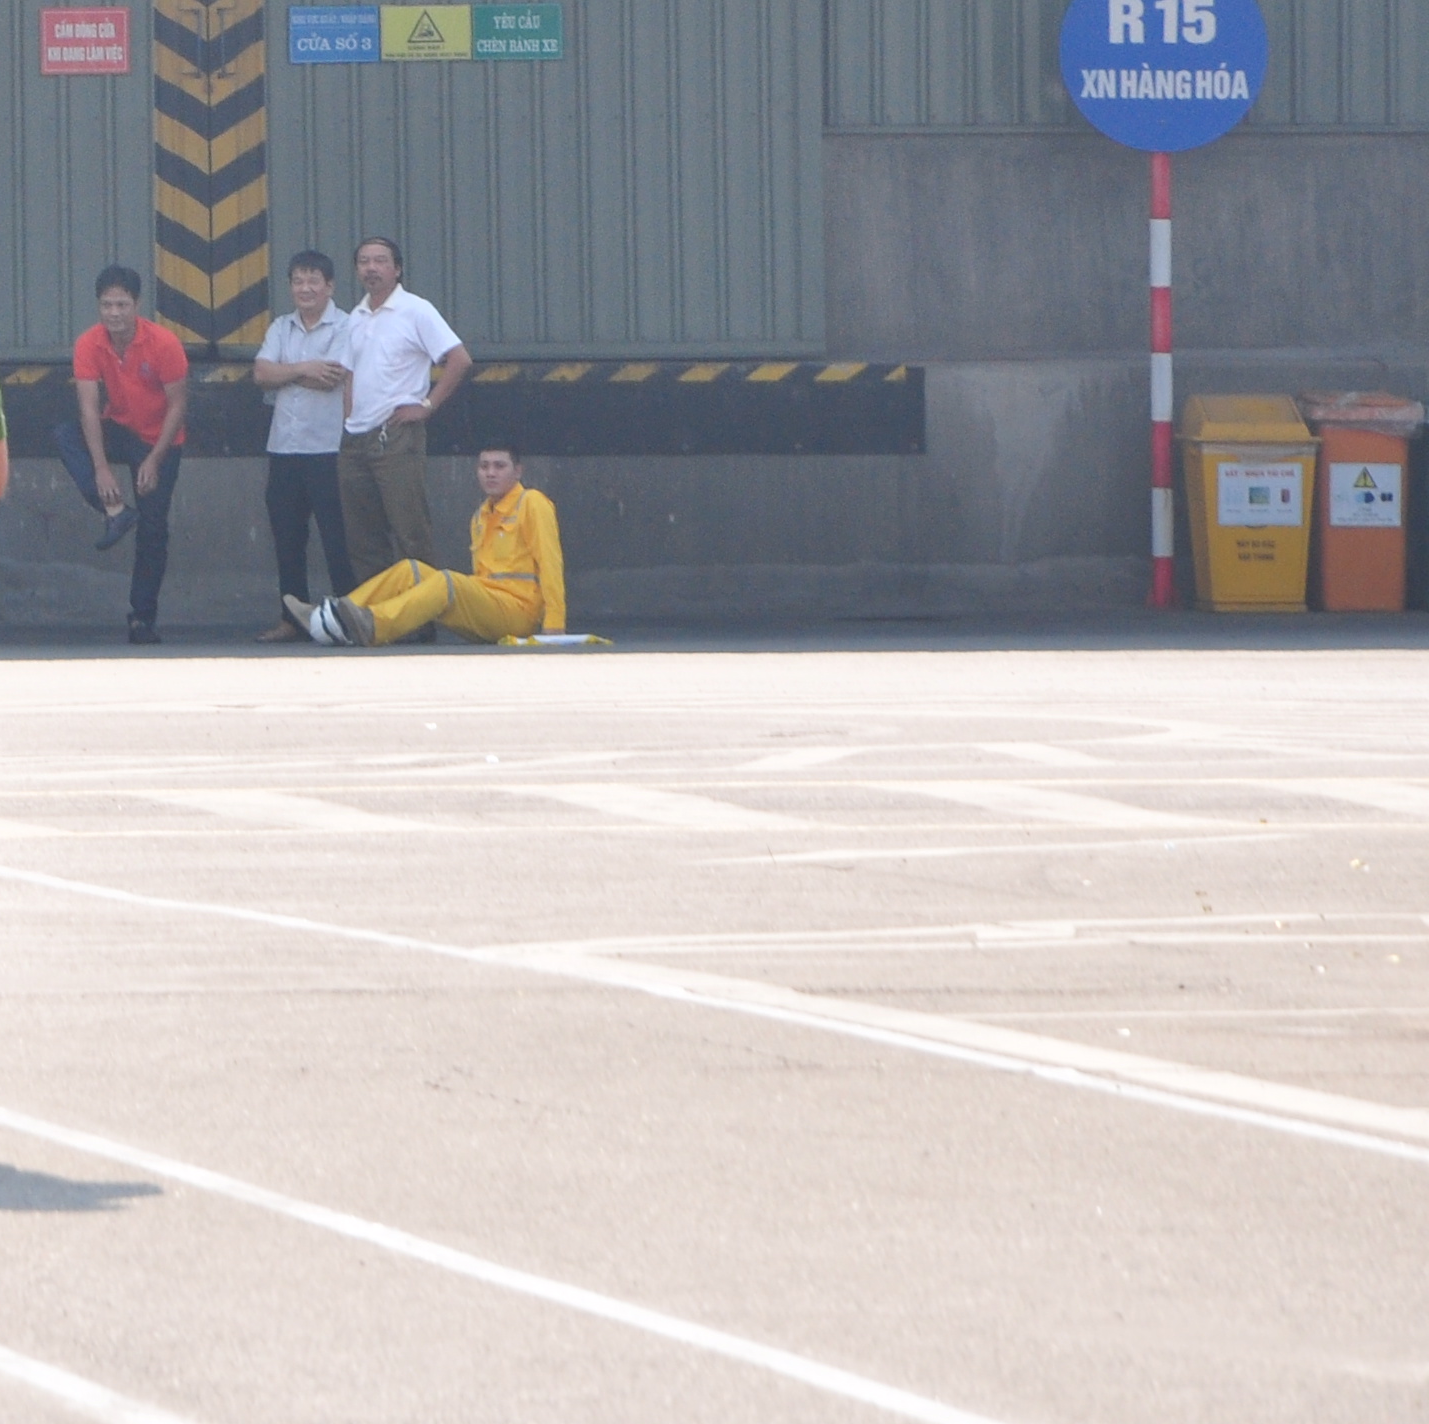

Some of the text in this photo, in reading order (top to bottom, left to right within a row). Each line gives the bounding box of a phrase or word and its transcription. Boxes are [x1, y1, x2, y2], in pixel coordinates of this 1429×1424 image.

[335, 31, 359, 51] SỐ
[361, 37, 373, 51] 3
[541, 38, 559, 53] XE
[1080, 61, 1250, 100] XN HÀNG HÓA
